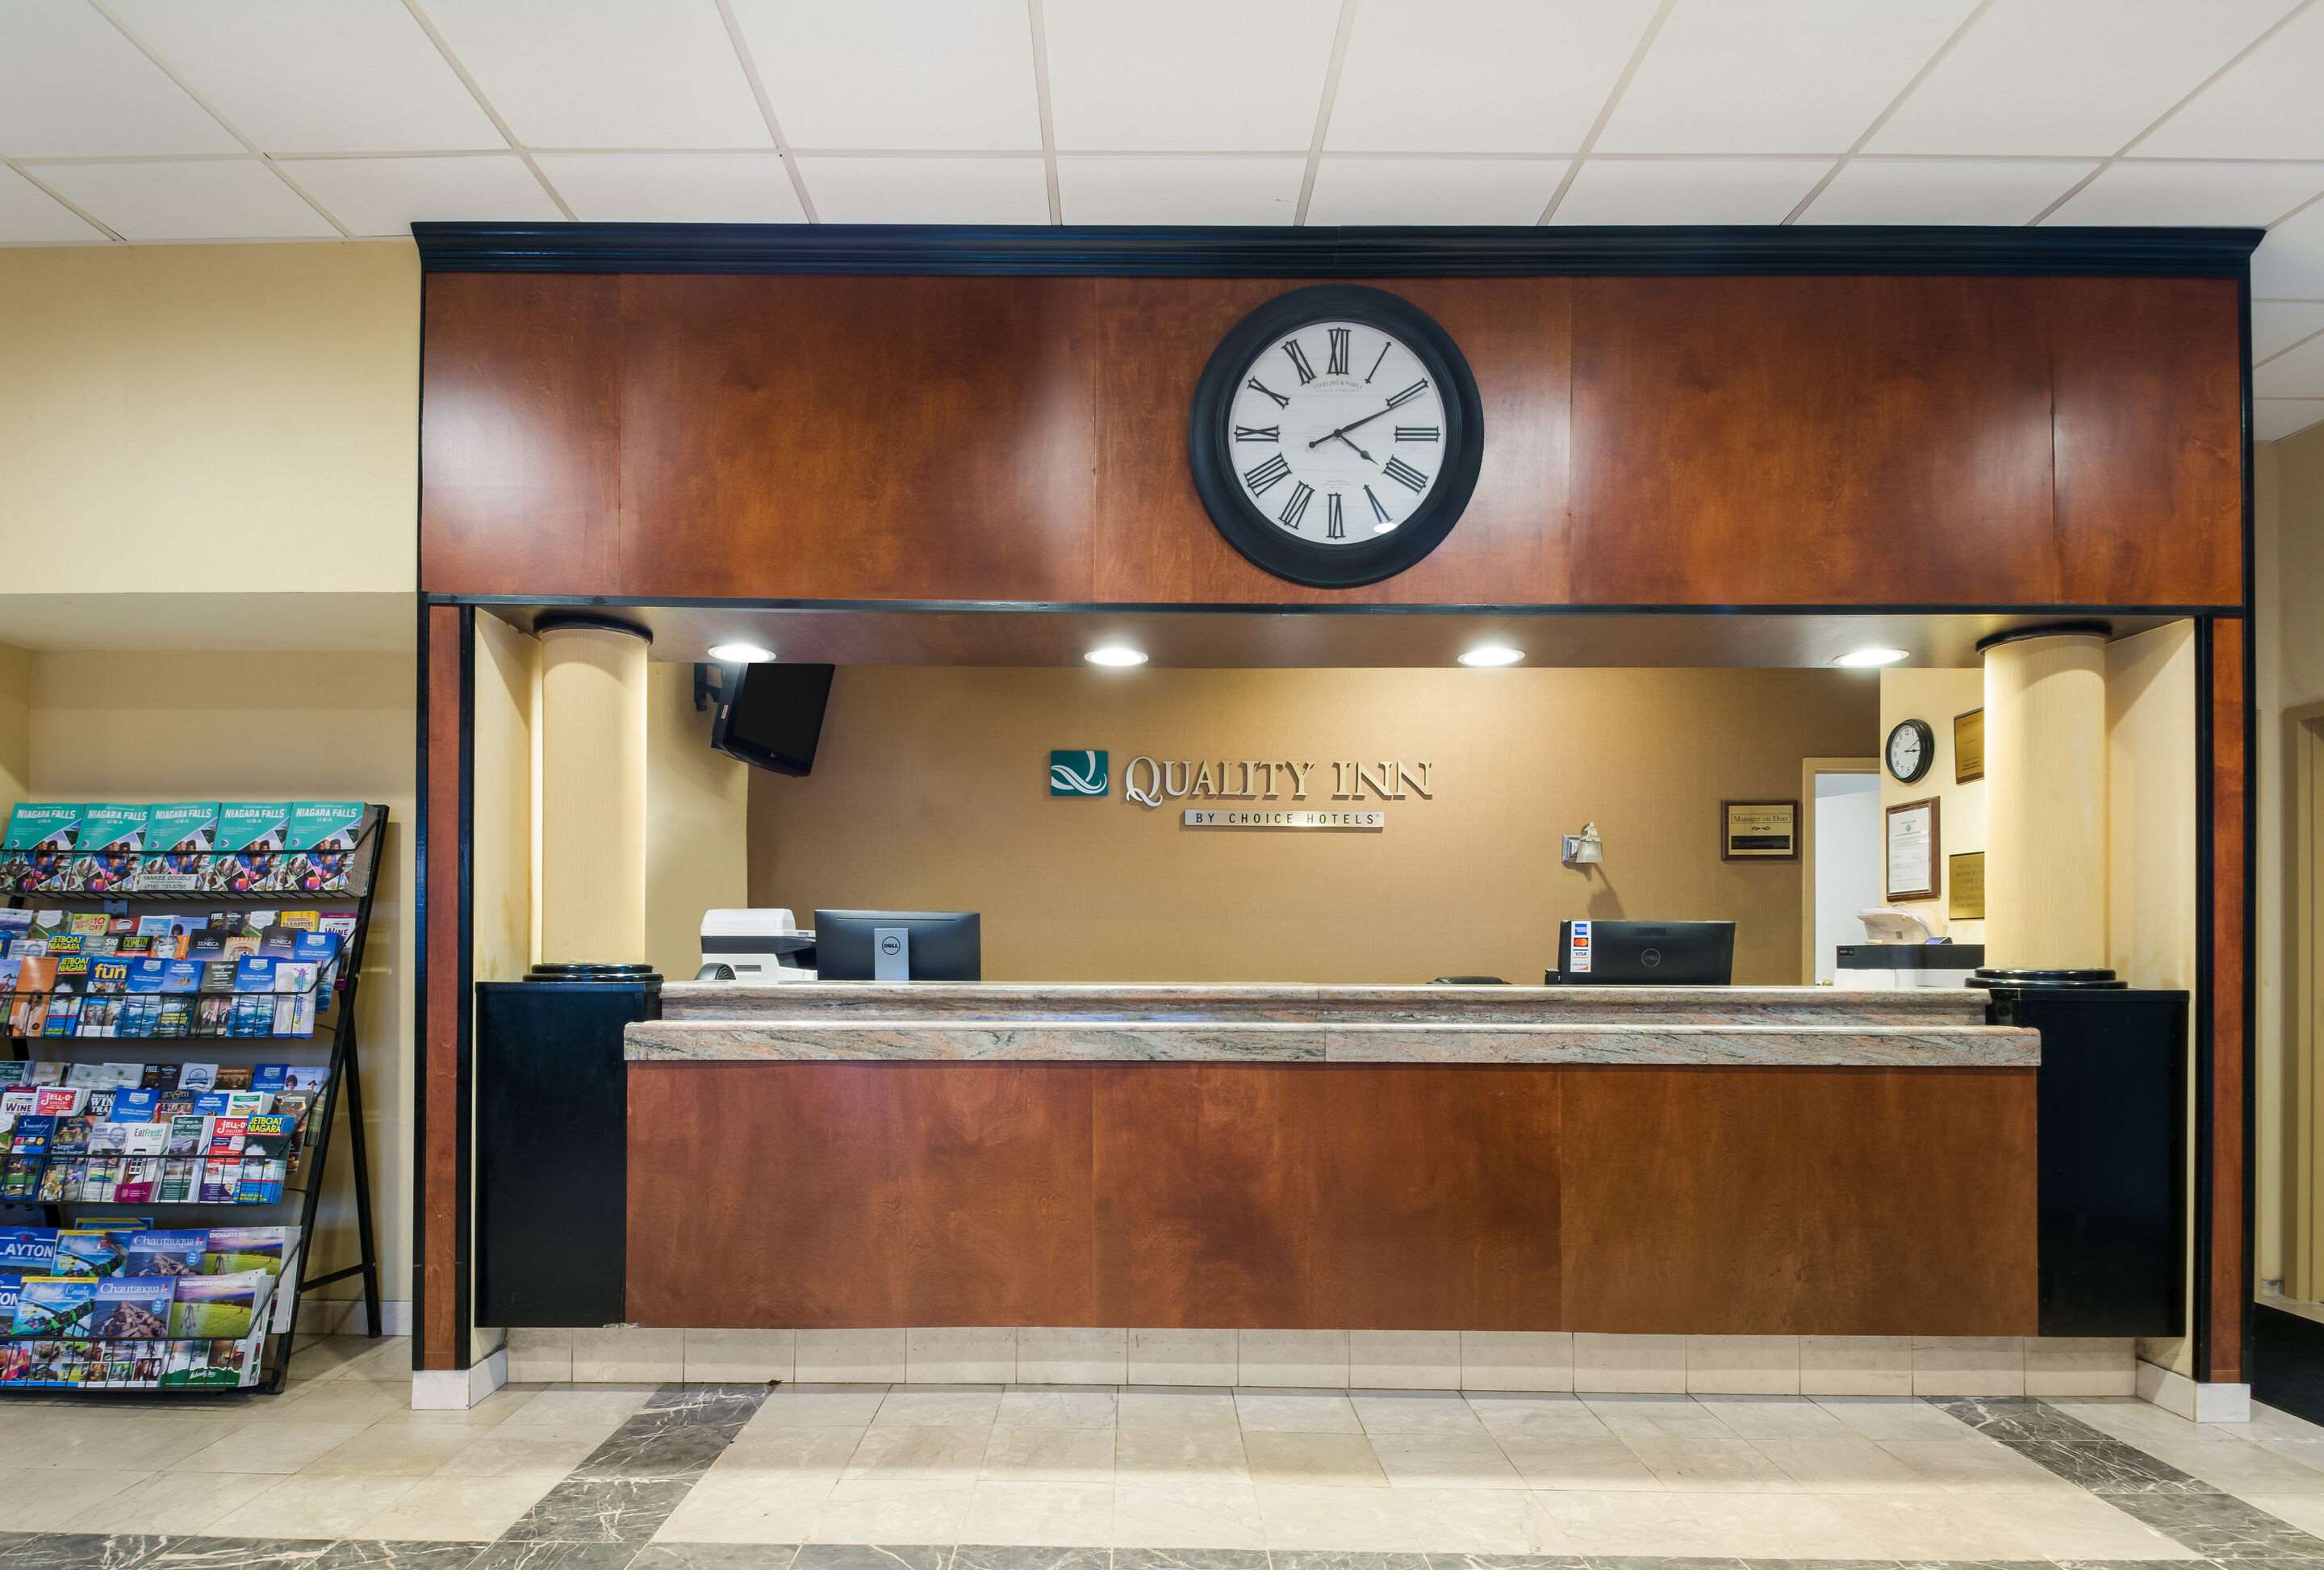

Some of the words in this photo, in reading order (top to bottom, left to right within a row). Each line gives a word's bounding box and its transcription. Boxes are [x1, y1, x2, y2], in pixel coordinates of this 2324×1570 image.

[1327, 327, 1352, 375] XII
[1281, 339, 1317, 386] XI
[1365, 341, 1392, 384] I
[1248, 376, 1290, 409] X
[1386, 377, 1428, 407] II
[1234, 425, 1281, 443] IX
[1394, 425, 1440, 443] III
[1244, 452, 1293, 498] VIII
[1278, 480, 1316, 530] VII
[1327, 492, 1346, 539] VI
[1125, 756, 1316, 806] QUALITY
[1332, 760, 1433, 799] INN
[16, 809, 50, 818] NIAGARA
[51, 809, 77, 819] FALLS
[87, 809, 122, 819] NIAGARA
[123, 810, 148, 821] FALLS
[155, 809, 187, 819] NIAGARA
[188, 808, 212, 818] FALLS
[225, 808, 260, 818] NIAGARA
[261, 808, 285, 818] FALLS
[295, 808, 332, 818] NIAGARA
[332, 808, 357, 818] FALLS
[1196, 813, 1214, 823] BY
[1228, 812, 1293, 824] CHOICE
[324, 927, 349, 936] WINE
[51, 935, 83, 944] JETBOAT
[48, 943, 82, 951] NIAGARA
[61, 957, 90, 965] JETBOAT
[58, 964, 88, 972] NIAGARA
[94, 963, 127, 979] fun
[41, 1092, 71, 1106] JELL-O
[90, 1098, 115, 1107] WIN
[6, 1103, 32, 1112] WINE
[216, 1120, 245, 1133] JELL-O
[249, 1117, 284, 1125] JETBOAT
[247, 1124, 282, 1133] NIAGARA
[134, 1235, 194, 1247] Chautauqua
[0, 1243, 54, 1258] AYTON
[100, 1283, 160, 1296] Chautauqua
